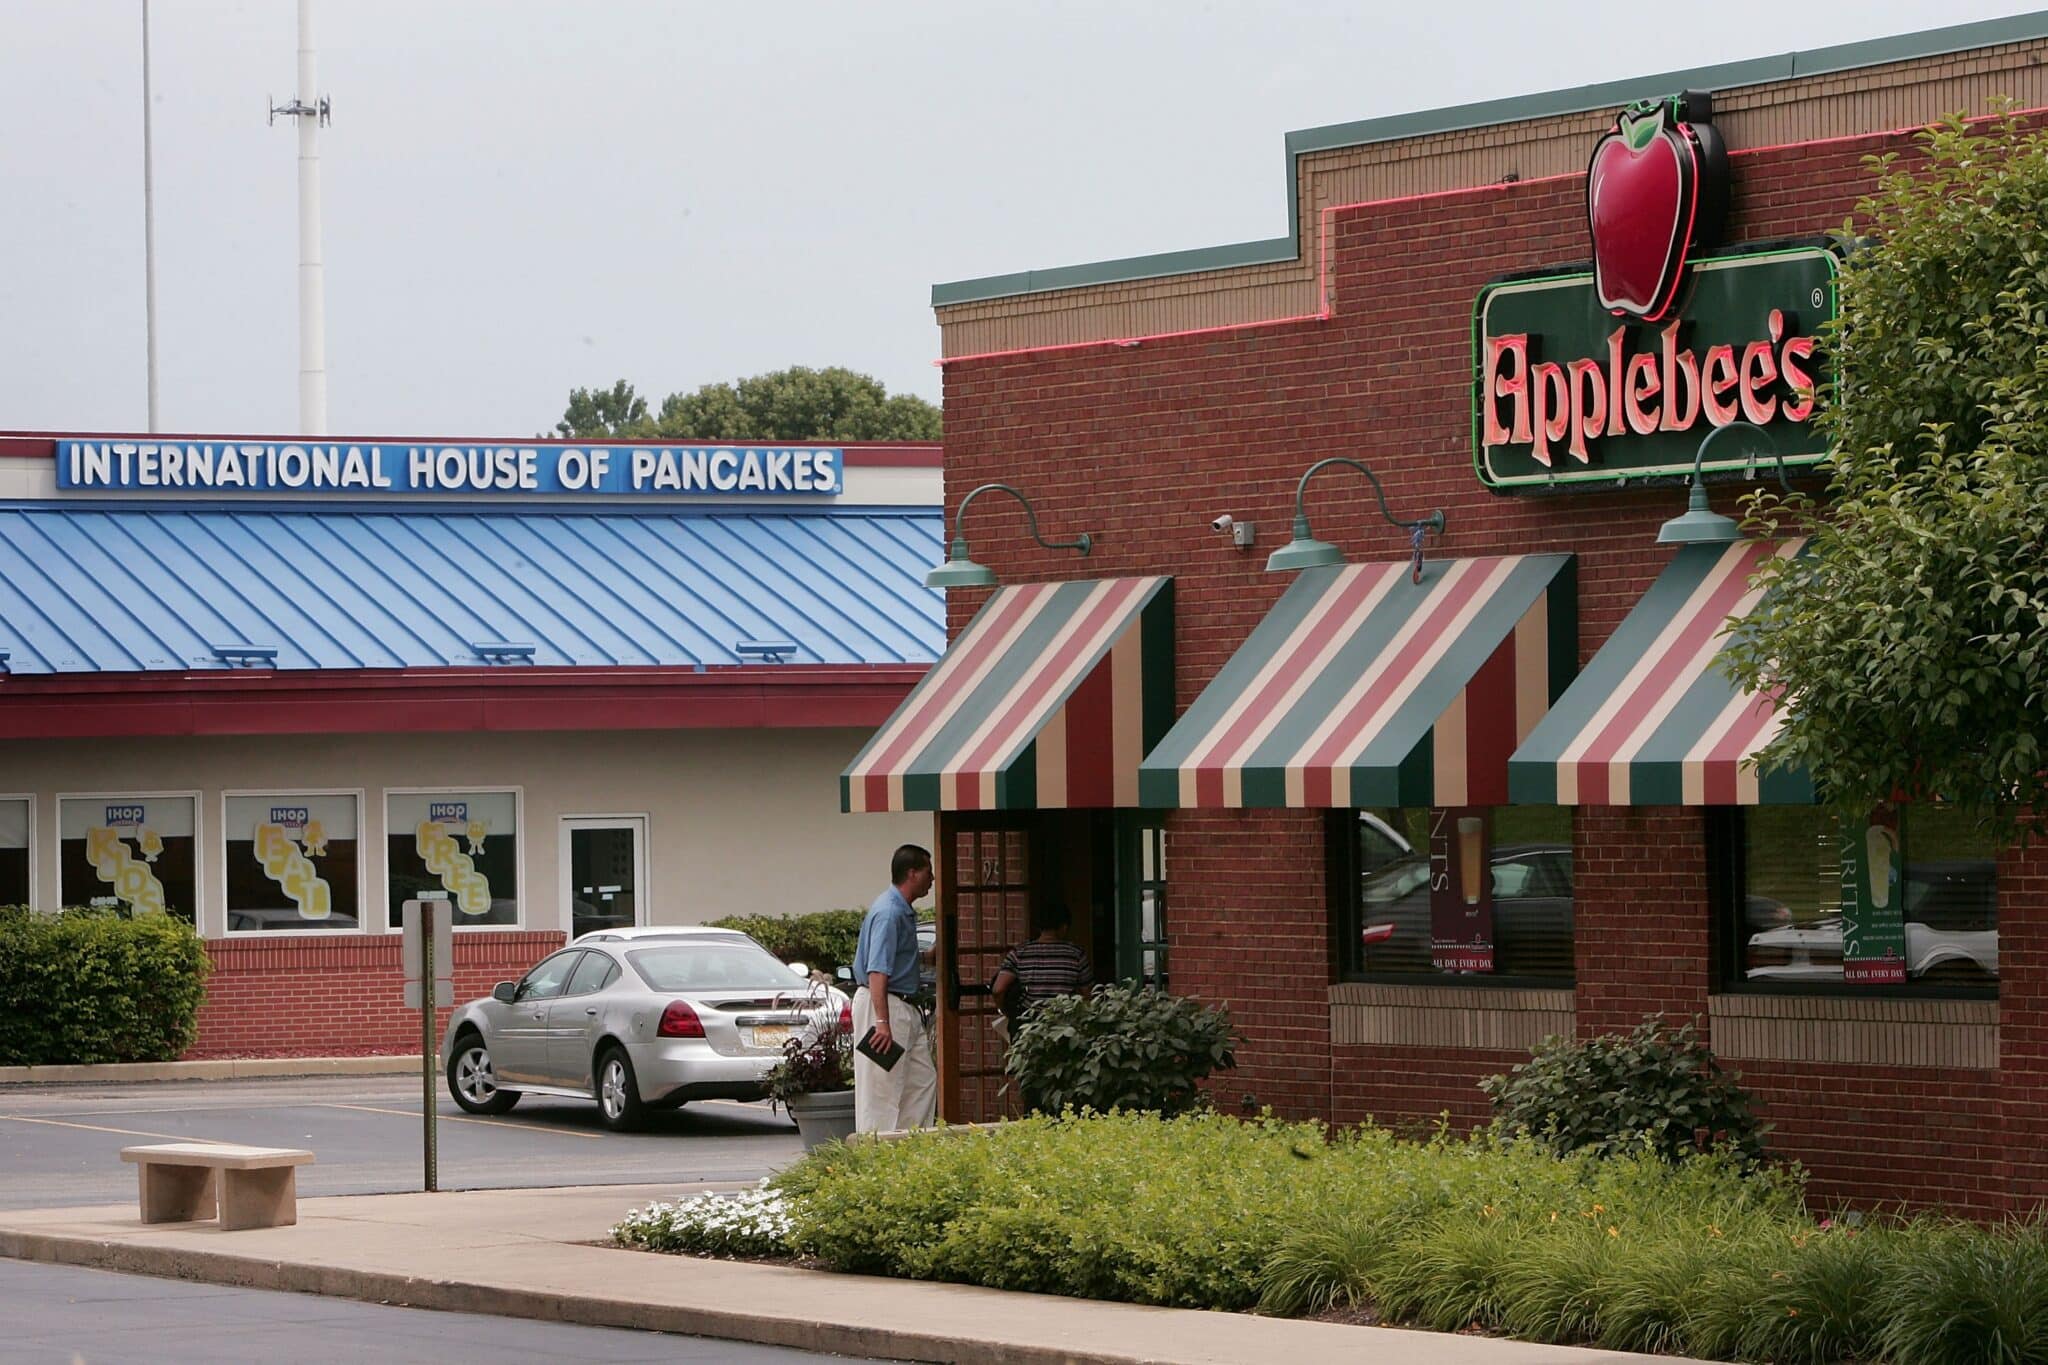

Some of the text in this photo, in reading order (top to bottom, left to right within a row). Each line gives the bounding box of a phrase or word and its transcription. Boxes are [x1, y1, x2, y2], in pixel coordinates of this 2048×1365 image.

[1481, 307, 1816, 468] Applebee's
[70, 443, 834, 491] INTERNATIONAL HOUSE OF PANCAKES
[107, 807, 143, 822] IHOP
[272, 809, 307, 824] IHOP
[431, 805, 466, 819] IHOP
[1840, 814, 1860, 956] ARITAS
